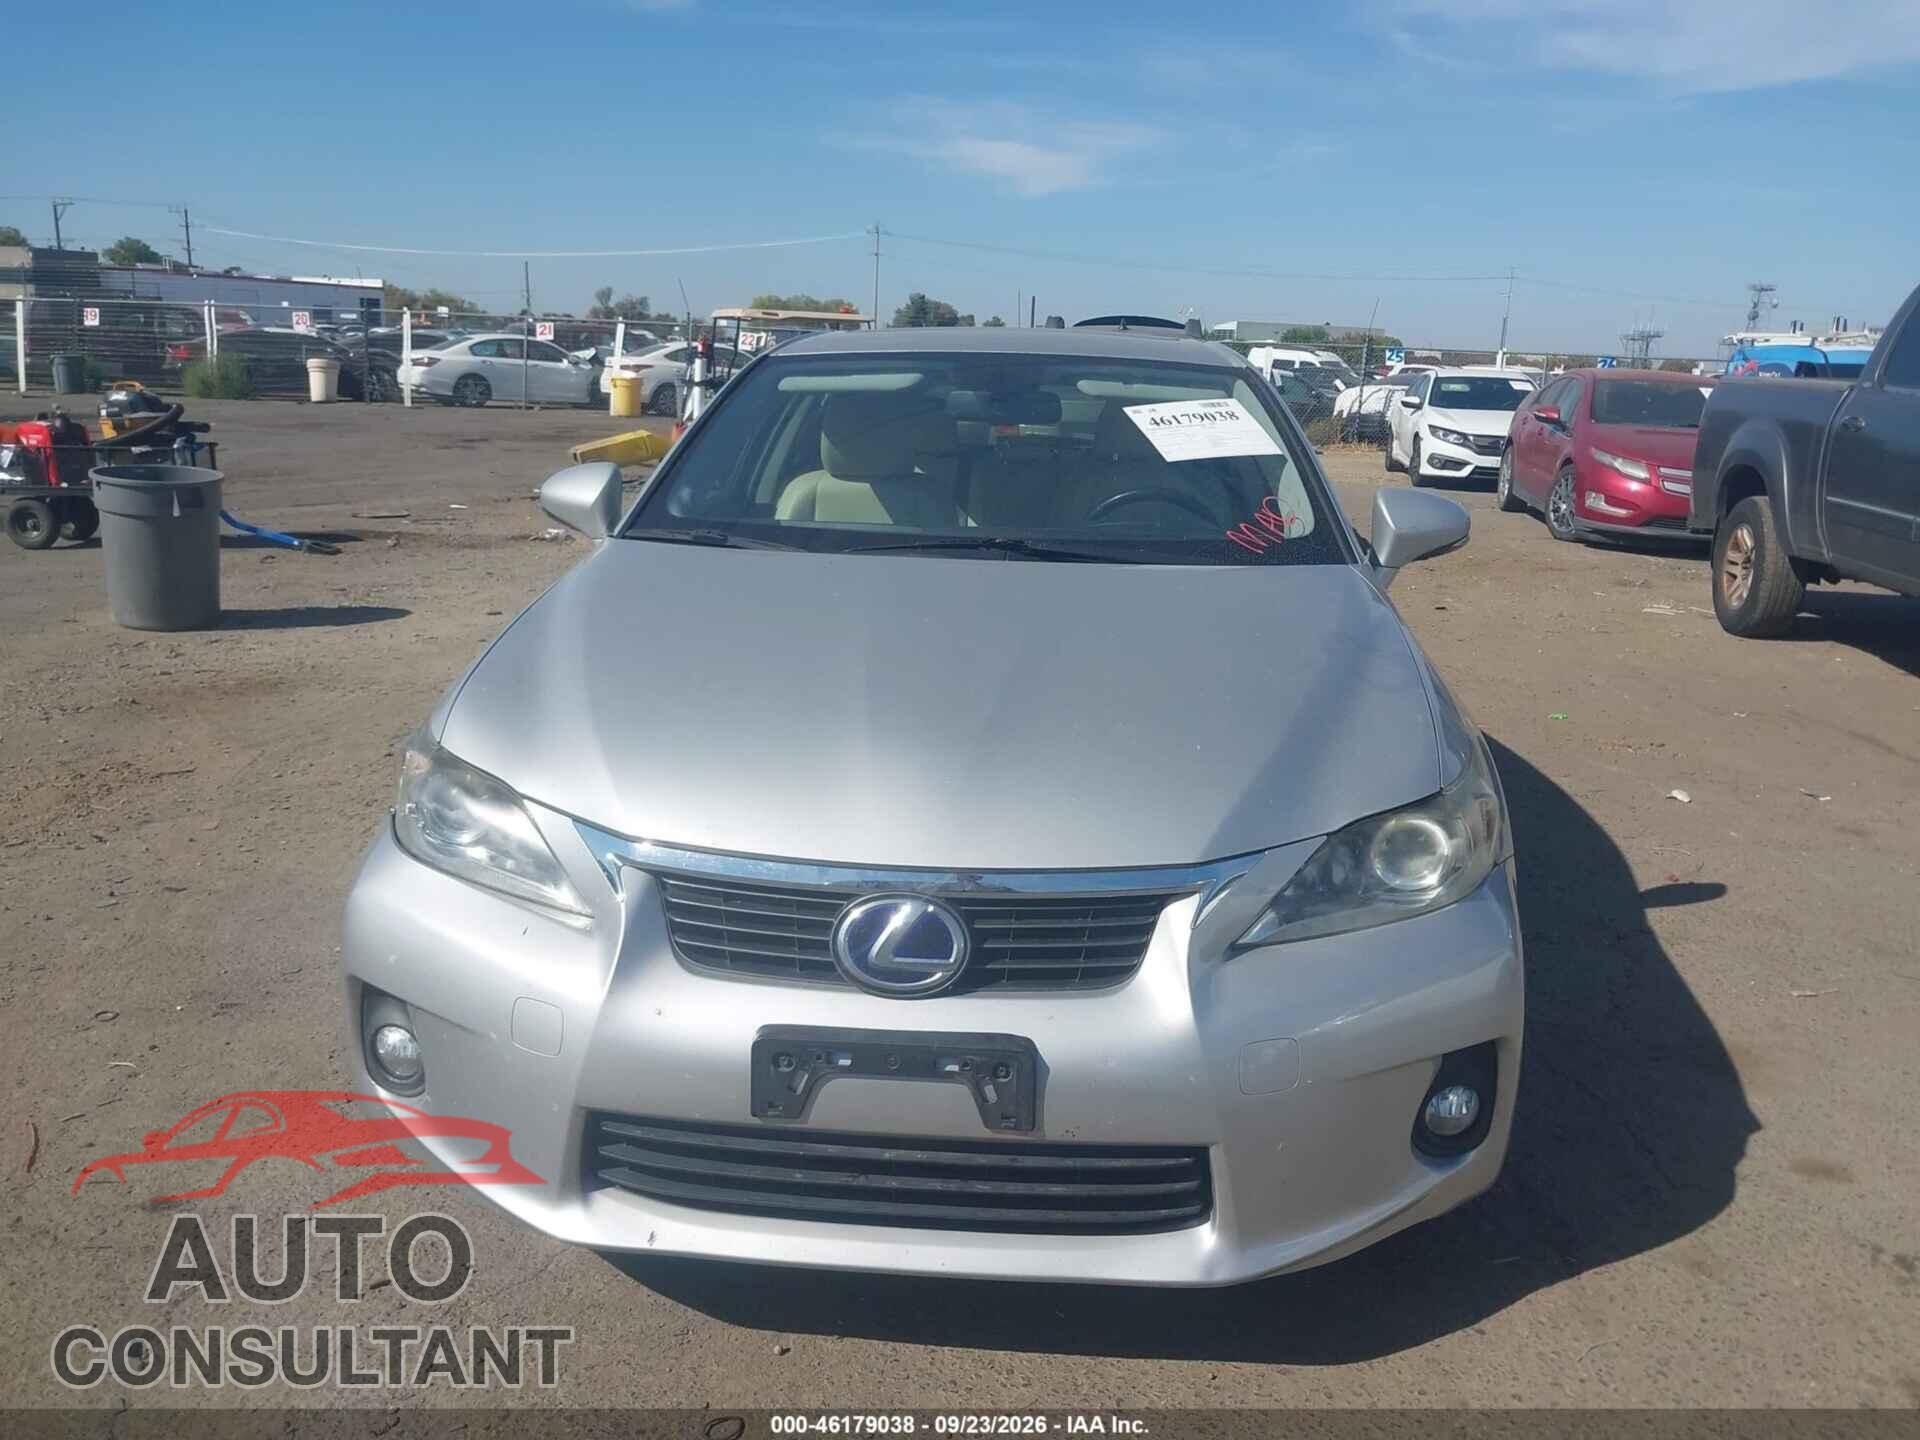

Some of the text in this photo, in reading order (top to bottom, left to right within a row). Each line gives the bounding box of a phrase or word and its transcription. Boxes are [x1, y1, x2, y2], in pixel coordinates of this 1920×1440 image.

[85, 309, 98, 321] 19
[294, 313, 308, 326] 20
[538, 323, 553, 336] 21
[740, 334, 756, 346] 22
[1387, 348, 1403, 363] 25
[1149, 409, 1240, 427] 46179038
